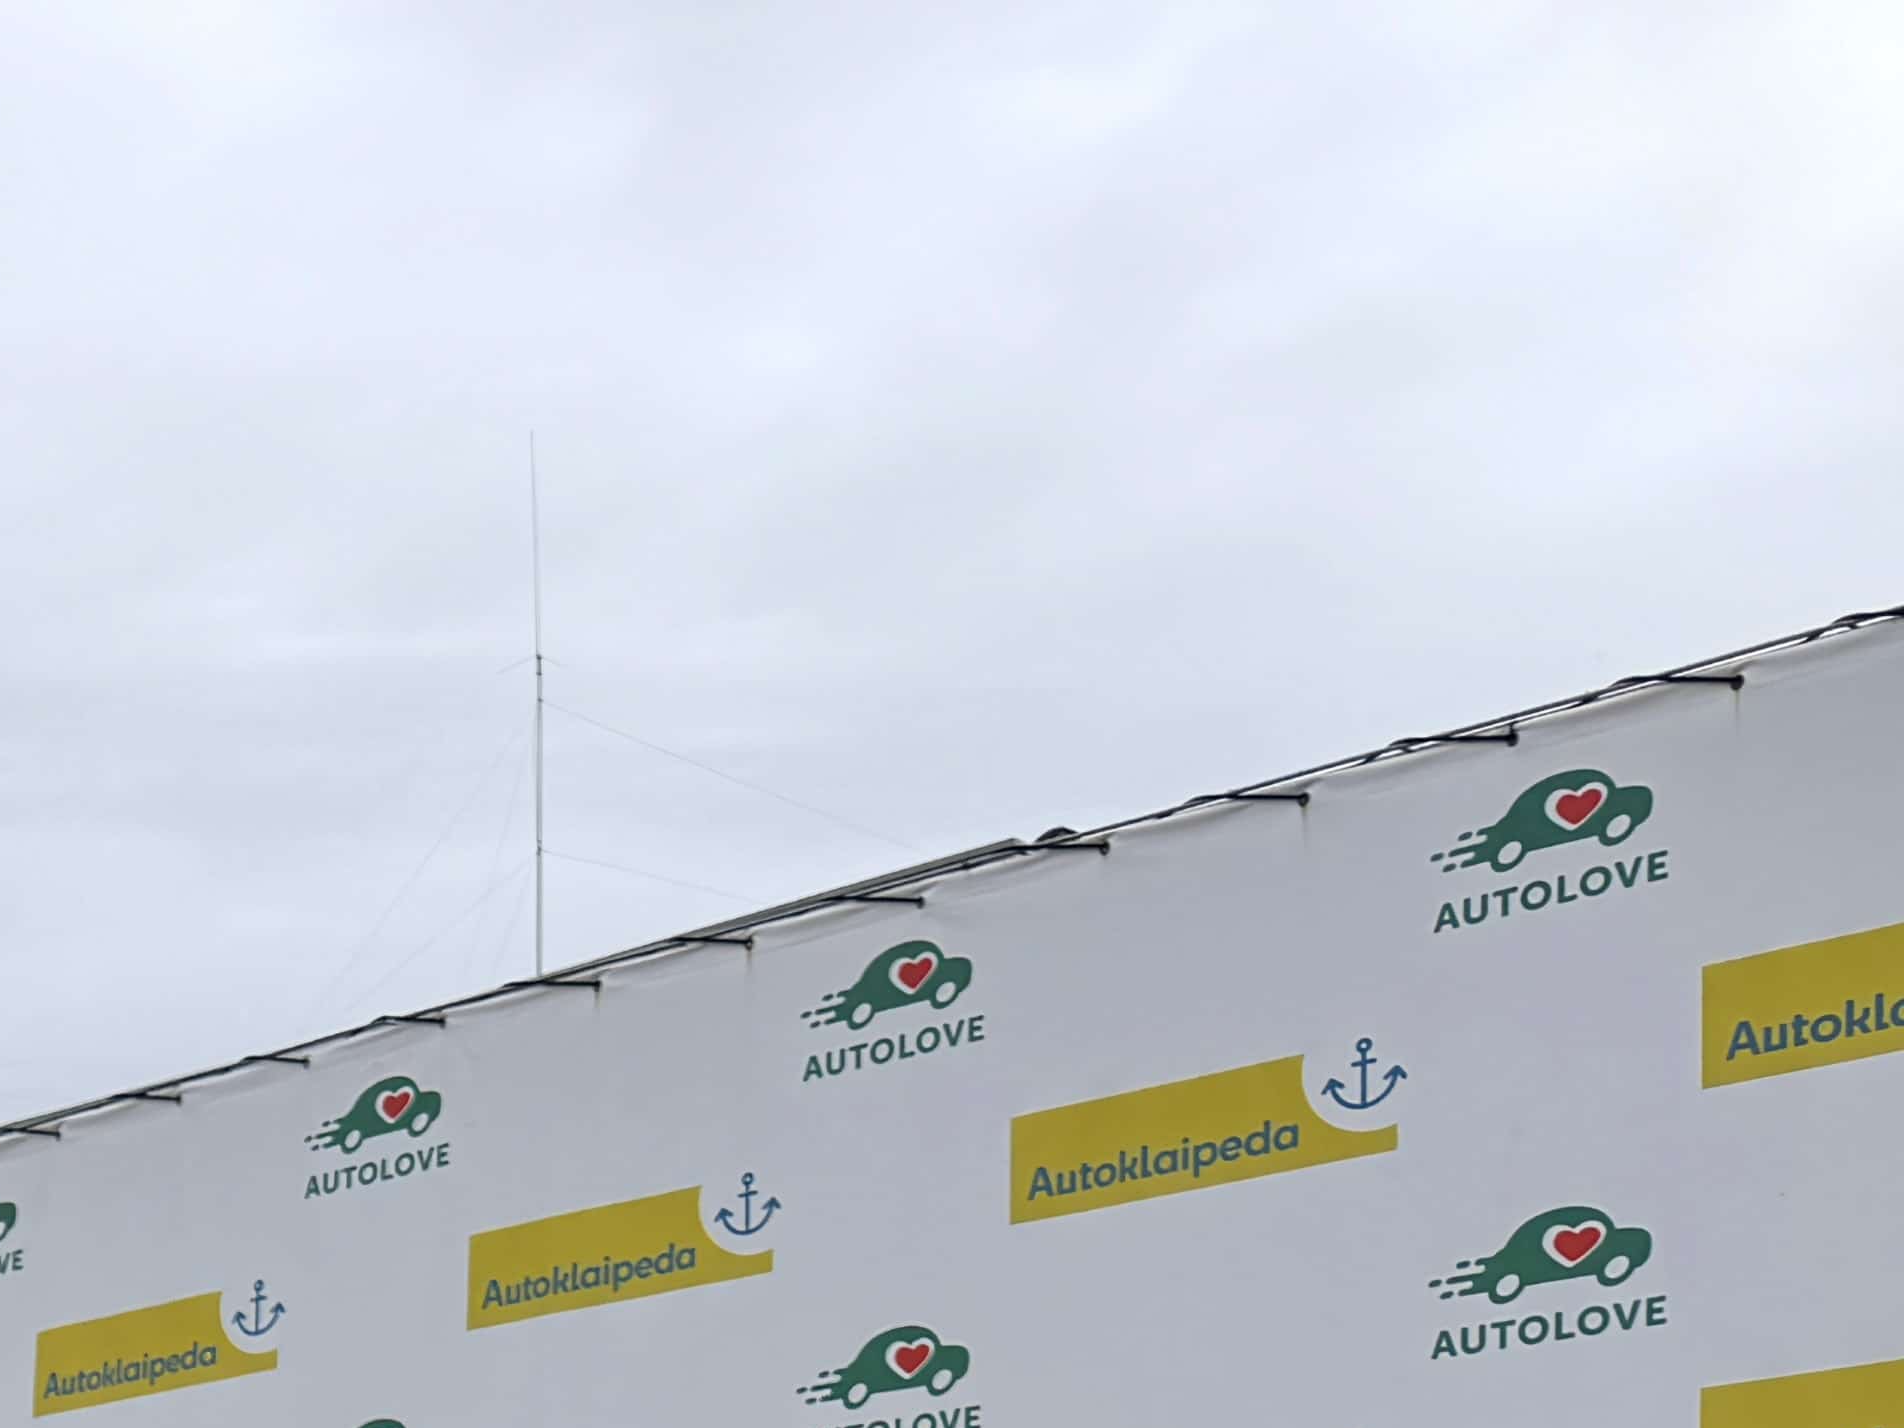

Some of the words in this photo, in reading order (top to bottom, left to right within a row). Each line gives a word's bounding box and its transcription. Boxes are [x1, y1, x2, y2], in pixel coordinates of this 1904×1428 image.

[1433, 850, 1669, 934] AUTOLOVE
[800, 1011, 985, 1082] AUTOLOVE
[304, 1142, 450, 1199] AUTOLOVE
[1027, 1119, 1300, 1201] Autoklaipeda
[482, 1242, 696, 1310] Autoklaipeda
[1431, 1295, 1667, 1360] AUTOLOVE
[43, 1341, 217, 1399] Autoklaipeda
